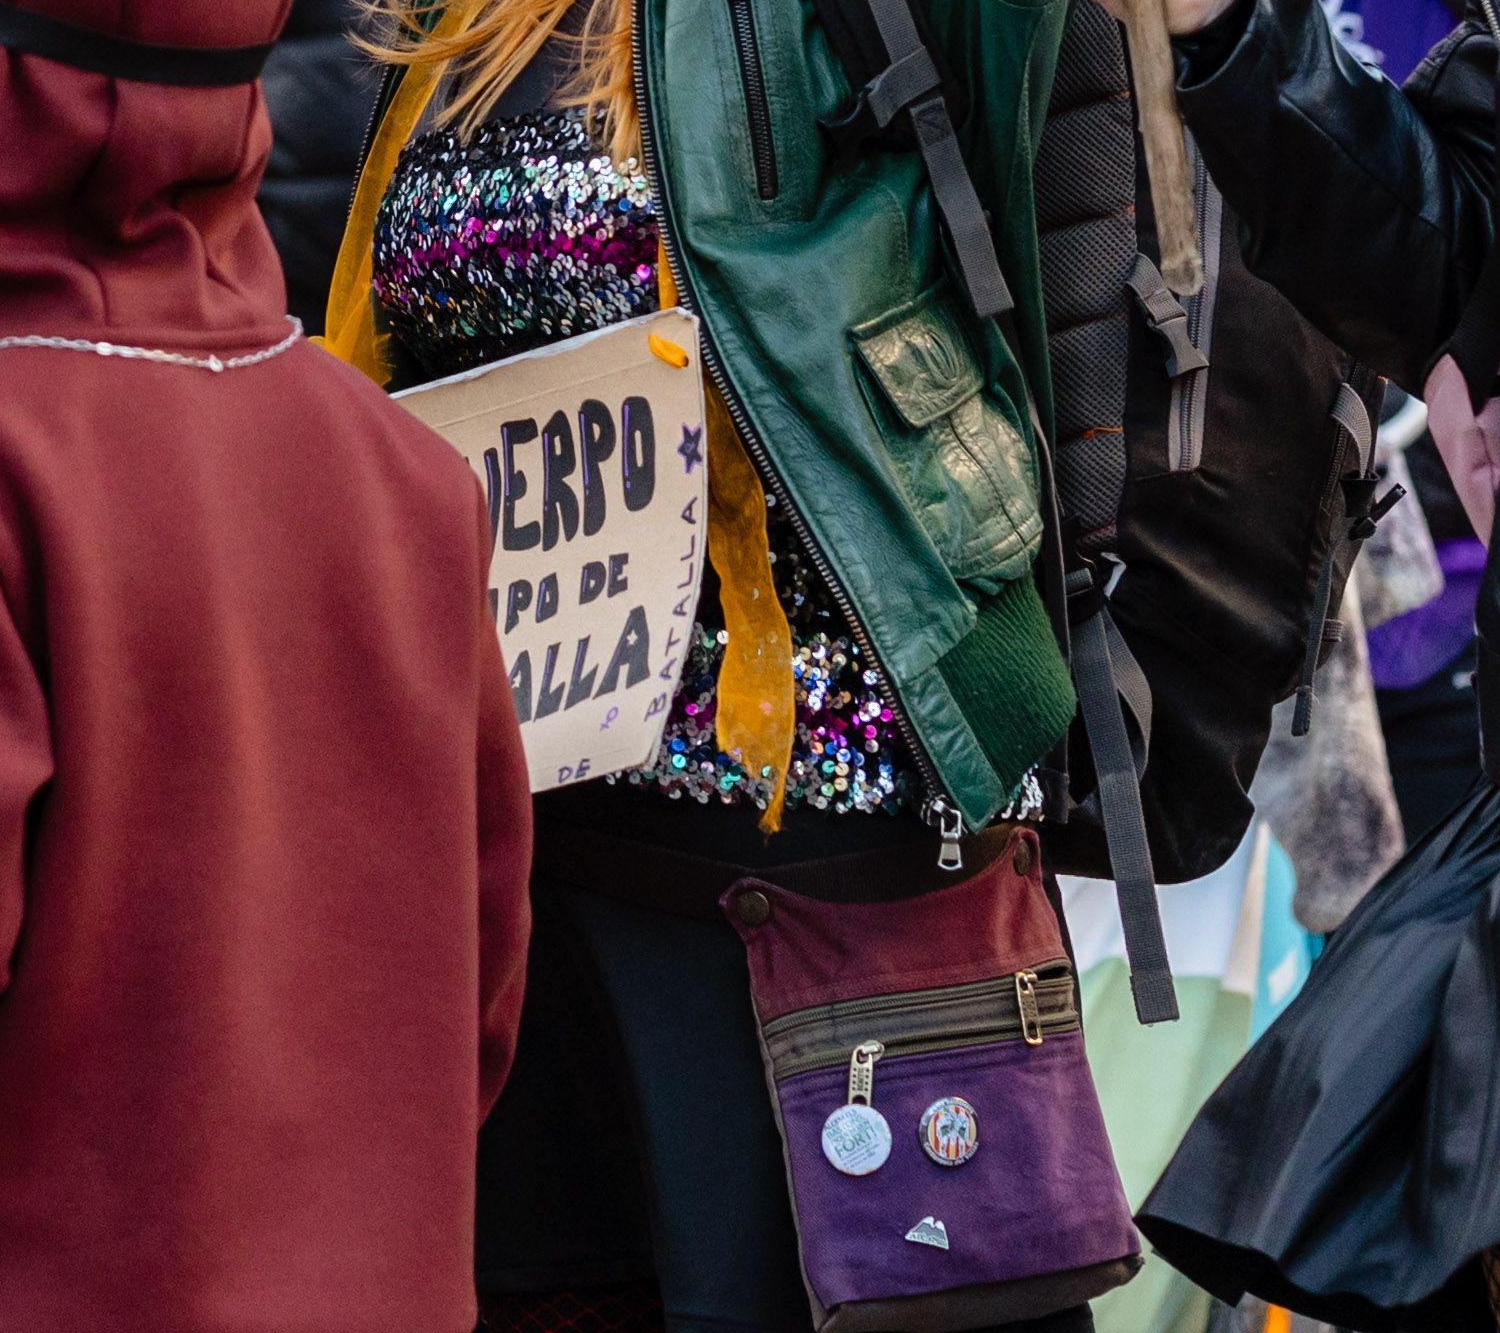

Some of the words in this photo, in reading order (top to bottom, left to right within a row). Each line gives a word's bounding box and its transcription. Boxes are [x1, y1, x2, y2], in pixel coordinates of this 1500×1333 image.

[579, 552, 630, 606] DE
[643, 494, 700, 723] BATALLA
[556, 757, 592, 785] DE
